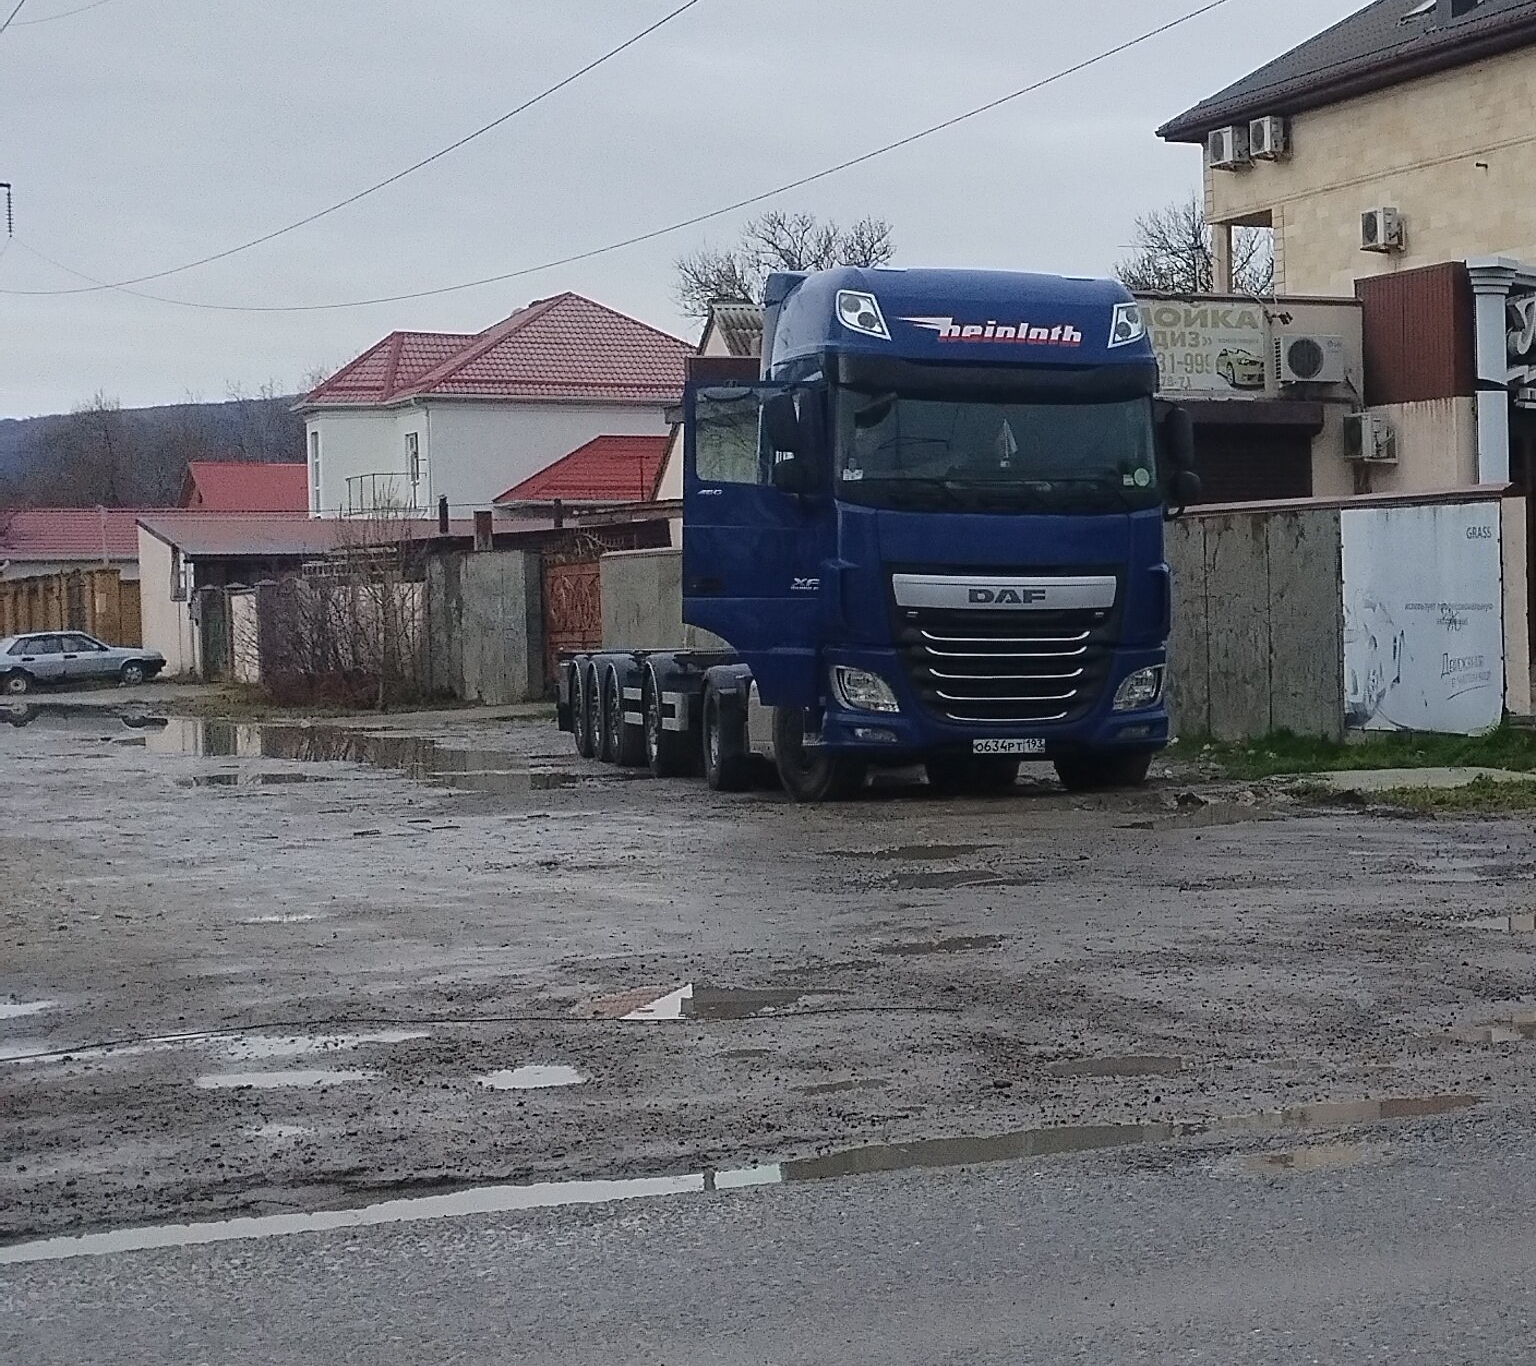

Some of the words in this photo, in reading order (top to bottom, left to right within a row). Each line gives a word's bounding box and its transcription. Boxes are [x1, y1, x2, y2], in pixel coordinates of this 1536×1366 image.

[1465, 526, 1492, 540] GRASS
[791, 577, 820, 587] XF
[968, 588, 1046, 604] DAF
